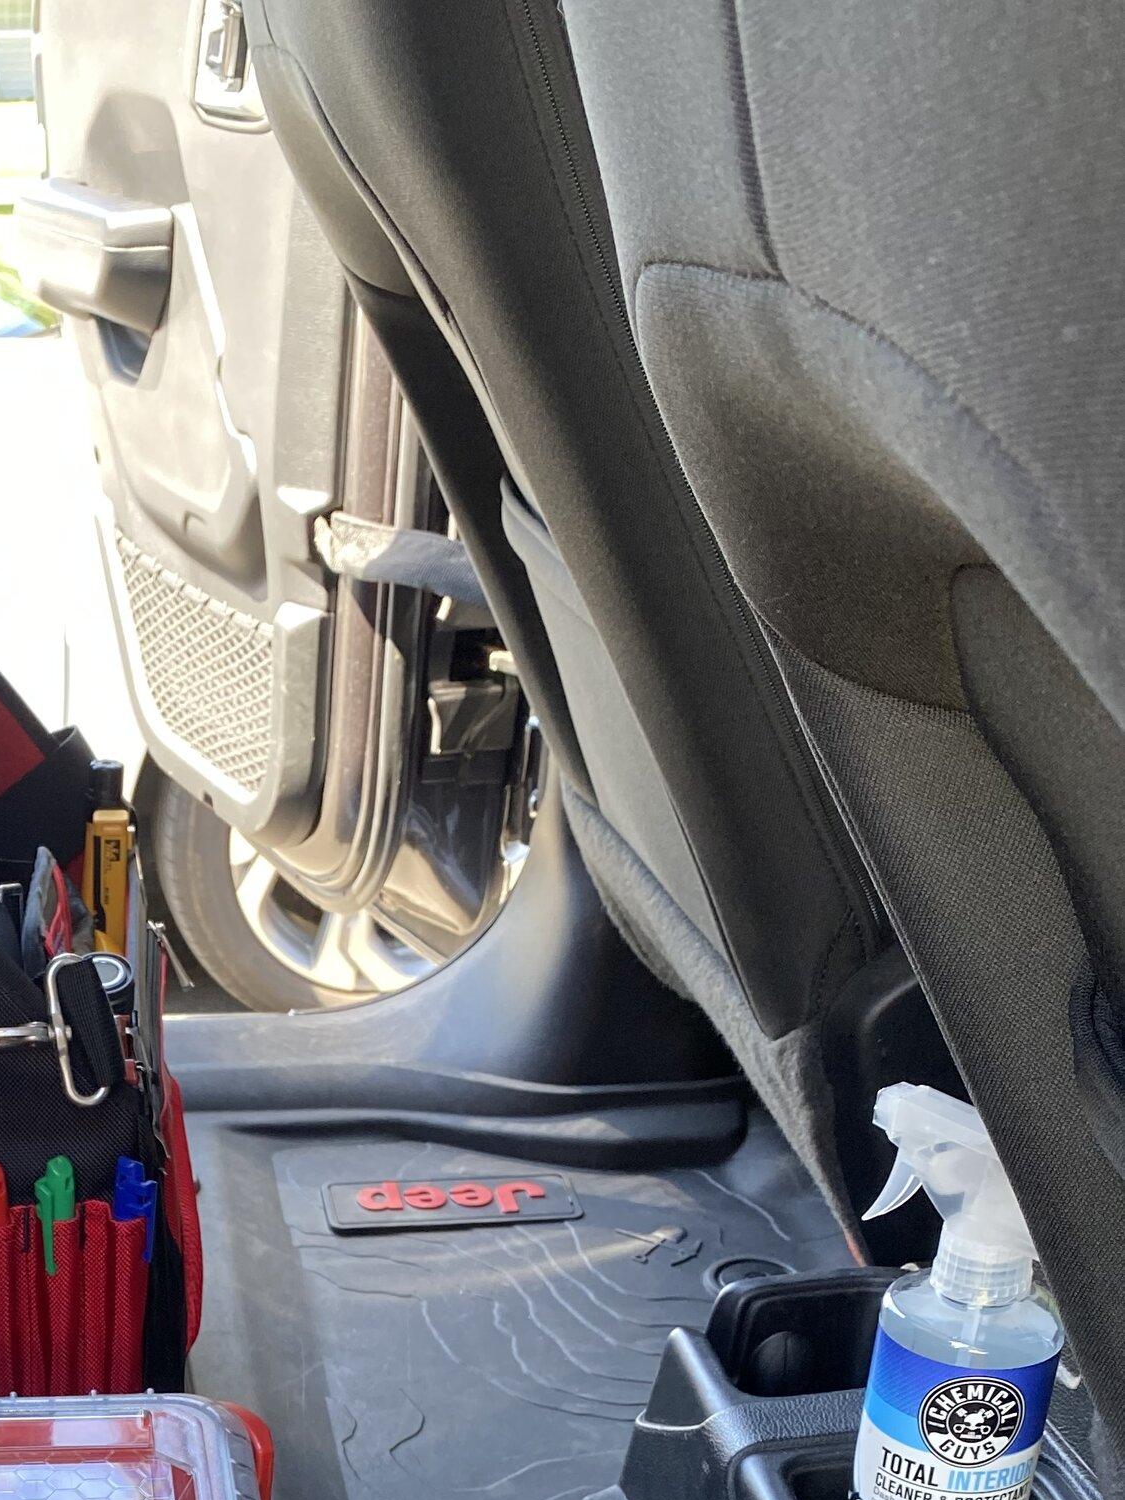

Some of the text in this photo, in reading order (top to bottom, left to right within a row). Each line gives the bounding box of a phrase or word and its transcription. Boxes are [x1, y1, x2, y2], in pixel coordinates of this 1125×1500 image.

[357, 1180, 546, 1214] Jeep
[928, 1384, 1018, 1424] CHEMICAL
[881, 1446, 939, 1487] TOTAL
[939, 1438, 996, 1460] GUYS
